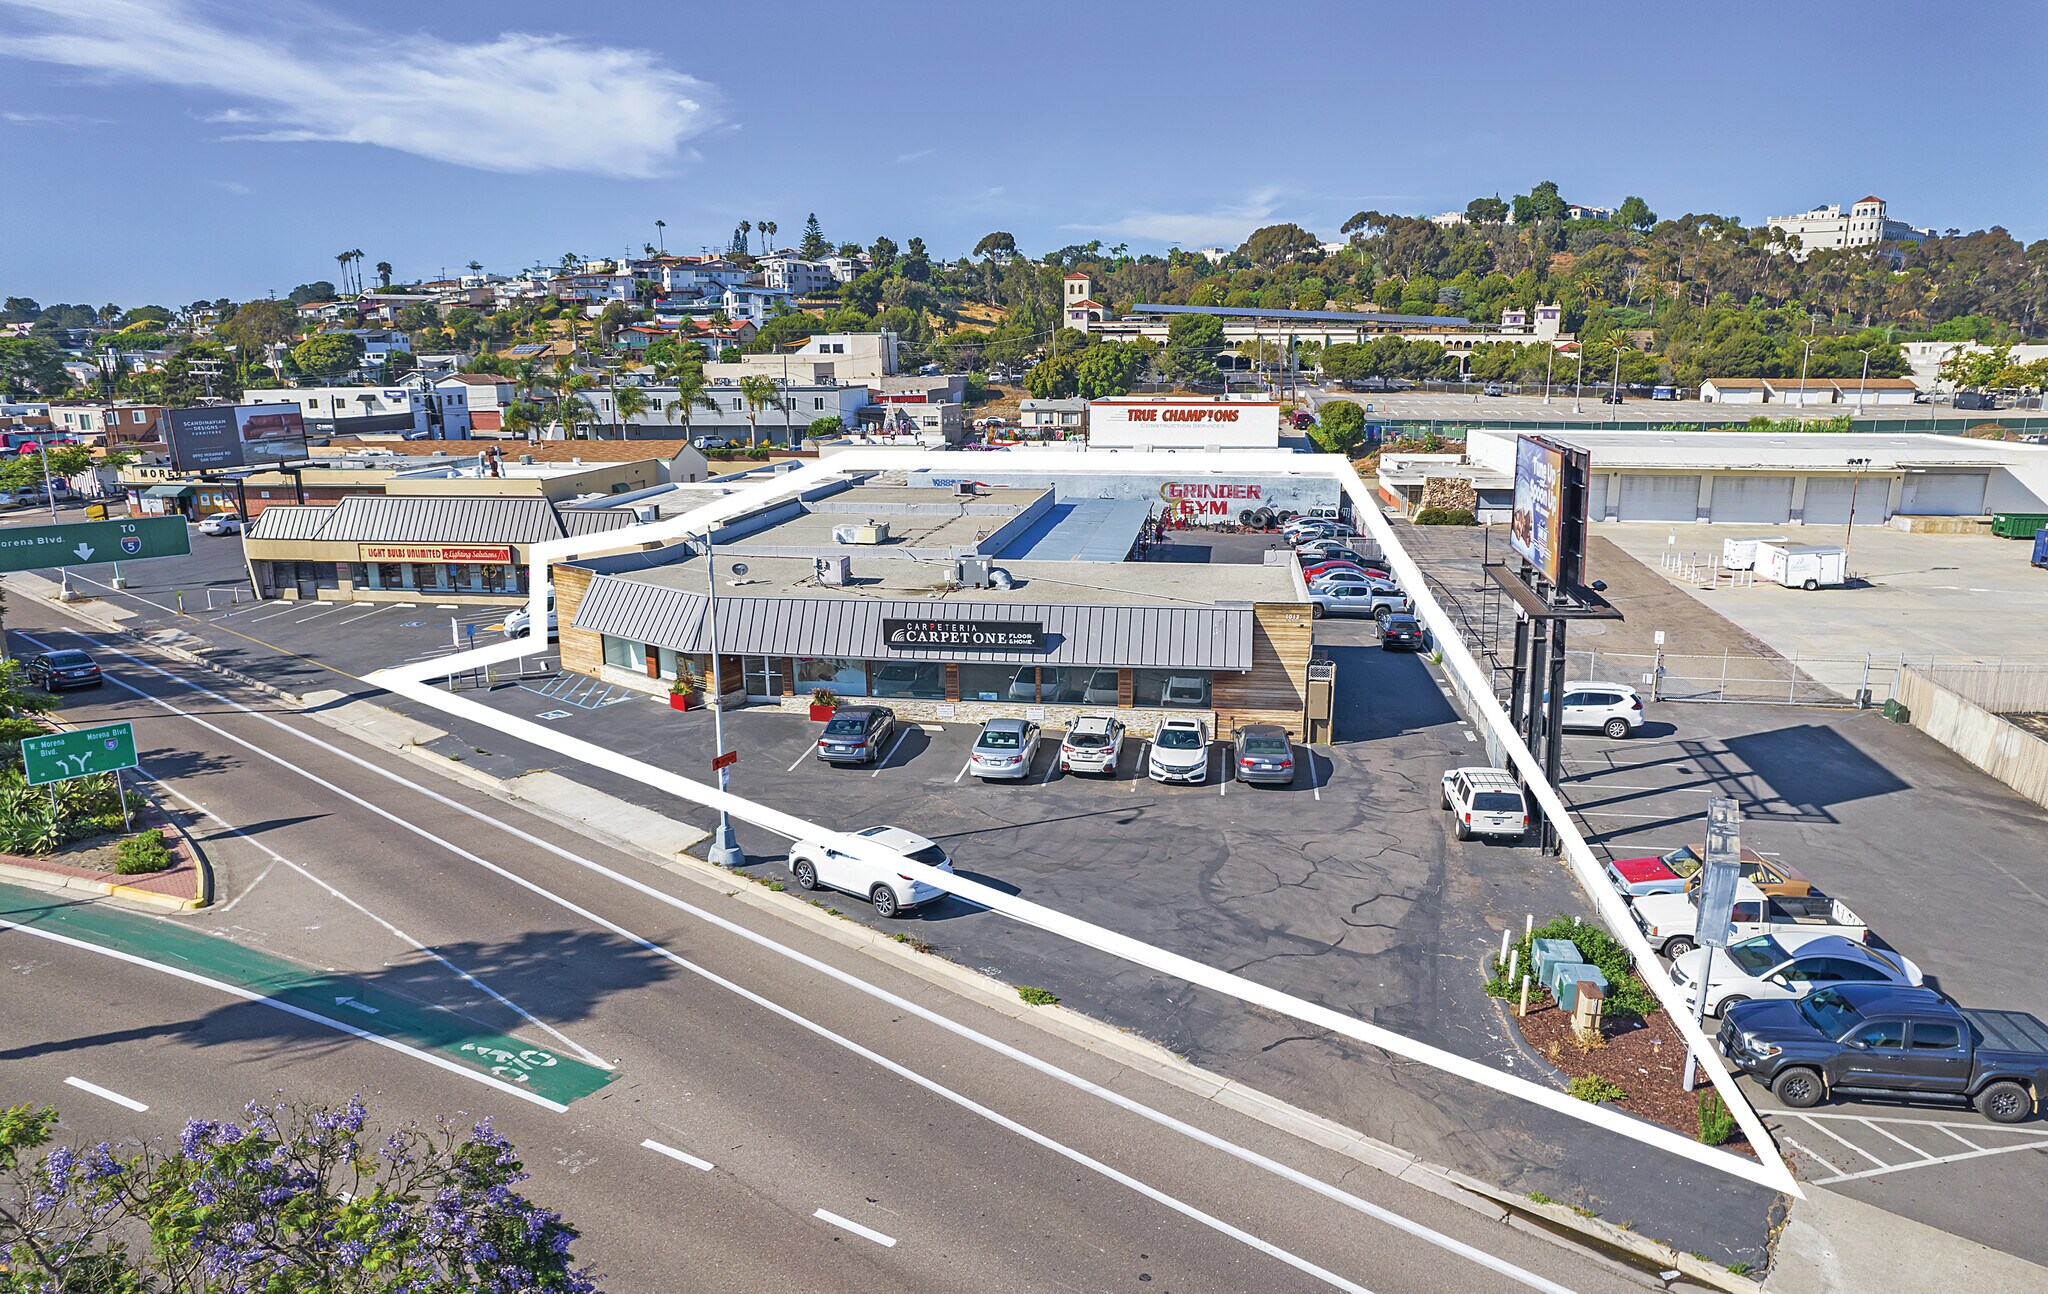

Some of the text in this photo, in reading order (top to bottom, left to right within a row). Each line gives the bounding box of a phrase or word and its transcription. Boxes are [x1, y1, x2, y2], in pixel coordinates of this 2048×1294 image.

[1128, 409, 1239, 422] TRUE CHAMPIONS
[183, 419, 226, 427] SCANDINAVIAN
[1547, 463, 1556, 490] Up
[1168, 483, 1262, 499] GRINDER
[1180, 500, 1228, 515] GYM
[1548, 489, 1557, 516] Up
[120, 523, 136, 533] TO
[0, 536, 65, 548] orena Blvd.
[127, 542, 135, 551] 5
[368, 548, 441, 559] LIGHT BULBS UNLIMITED
[472, 550, 497, 559] Solutions
[906, 622, 977, 632] CARPETERIA
[906, 631, 1007, 644] CARPET ONE
[87, 728, 129, 740] Morena Blvd.
[40, 739, 65, 749] Morena
[40, 749, 58, 757] Blvd.
